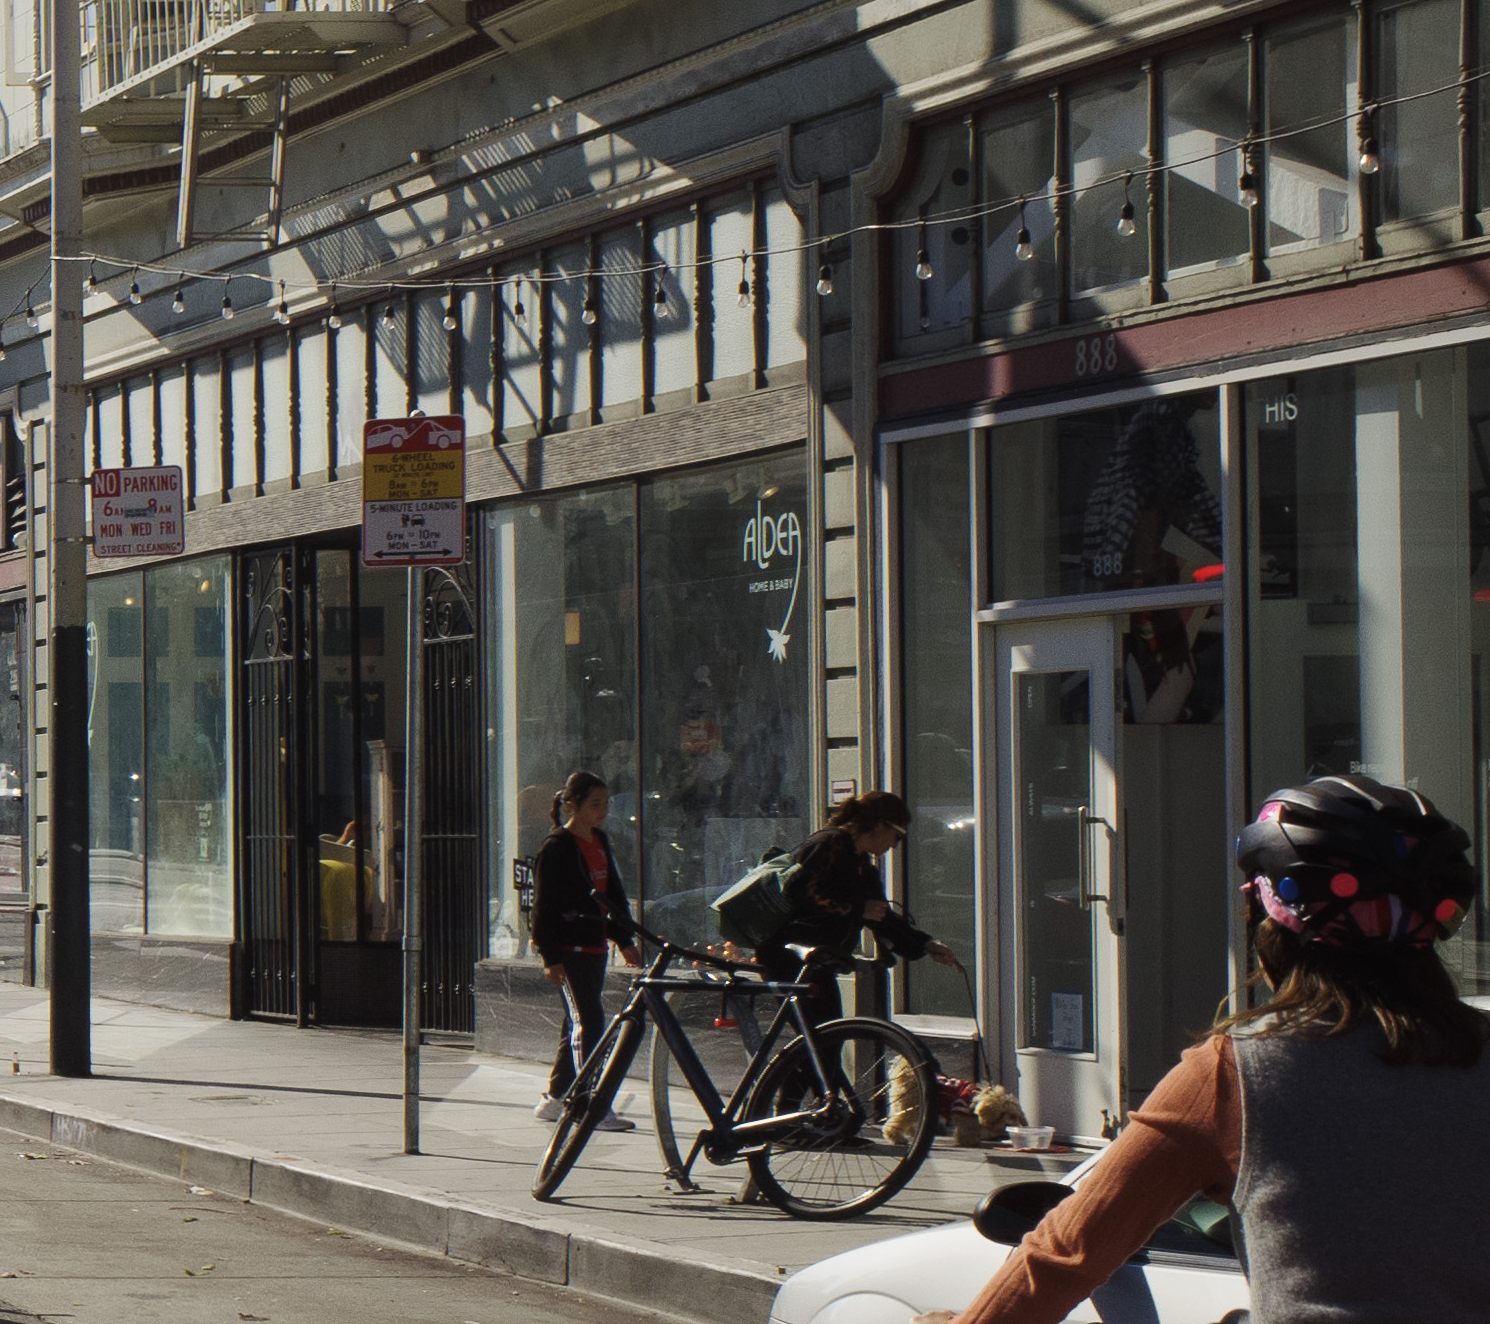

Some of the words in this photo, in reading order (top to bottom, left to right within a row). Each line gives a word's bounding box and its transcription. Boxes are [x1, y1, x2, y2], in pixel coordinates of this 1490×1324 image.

[1075, 333, 1118, 376] 888
[373, 464, 407, 473] TRUCK
[410, 461, 456, 472] LOADING
[94, 472, 118, 495] NO
[123, 474, 178, 493] PARKING
[419, 488, 439, 497] SAT
[370, 502, 414, 514] 5-MINUTE
[415, 500, 458, 511] LOADING
[100, 523, 123, 538] MON
[130, 522, 152, 536] WED
[159, 521, 176, 535] FRI
[743, 500, 802, 569] ALDEA
[100, 544, 132, 554] STREET
[136, 542, 177, 553] CLEANING
[419, 540, 439, 549] SAT
[1093, 552, 1123, 576] 888
